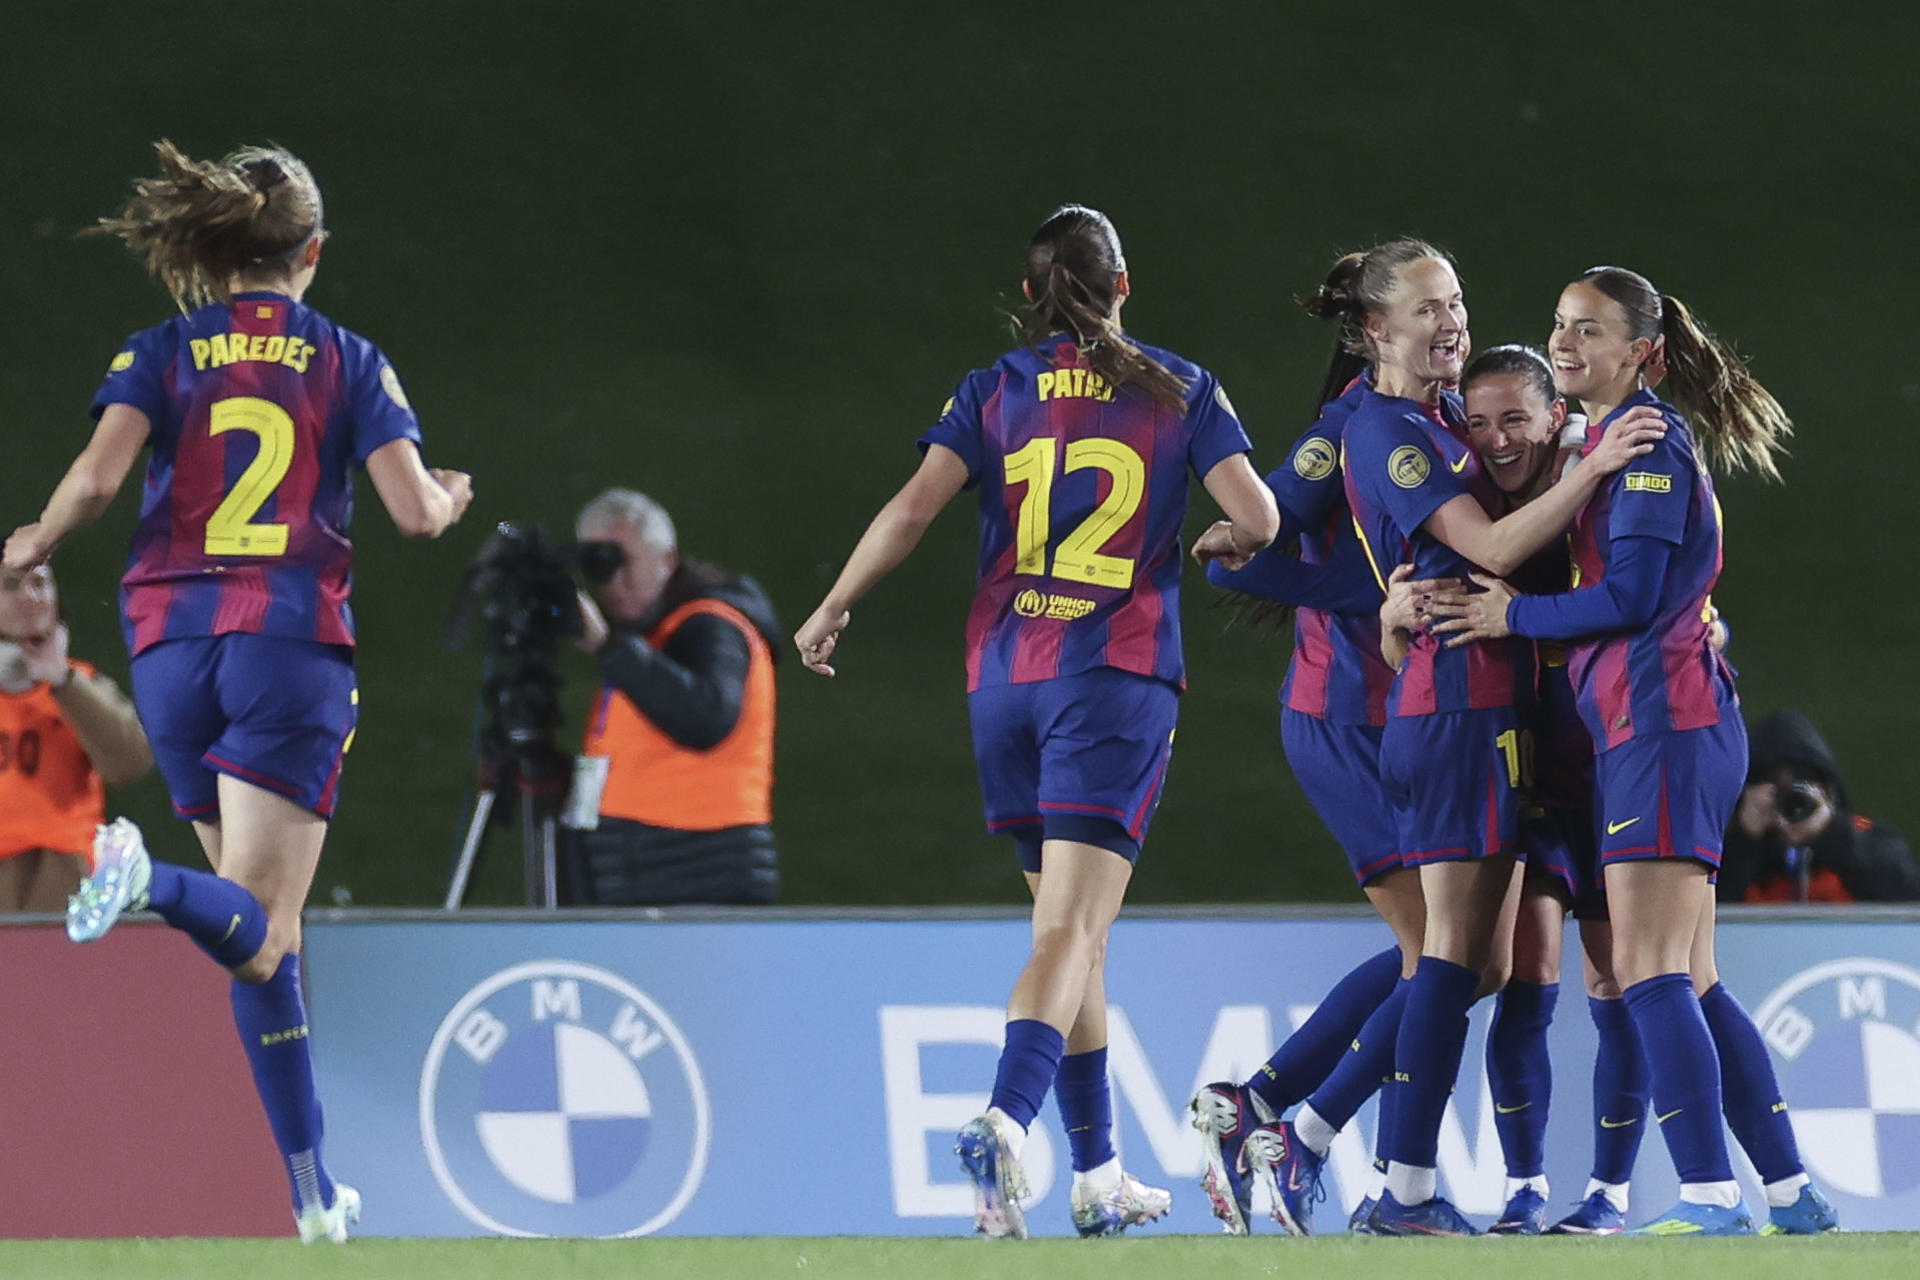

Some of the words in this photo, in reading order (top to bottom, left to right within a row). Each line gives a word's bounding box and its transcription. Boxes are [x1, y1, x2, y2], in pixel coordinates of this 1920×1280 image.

[190, 332, 316, 373] PAREDES
[204, 396, 295, 556] 2
[1003, 437, 1145, 589] 12
[456, 979, 662, 1062] BMW
[1764, 976, 1920, 1062] BM
